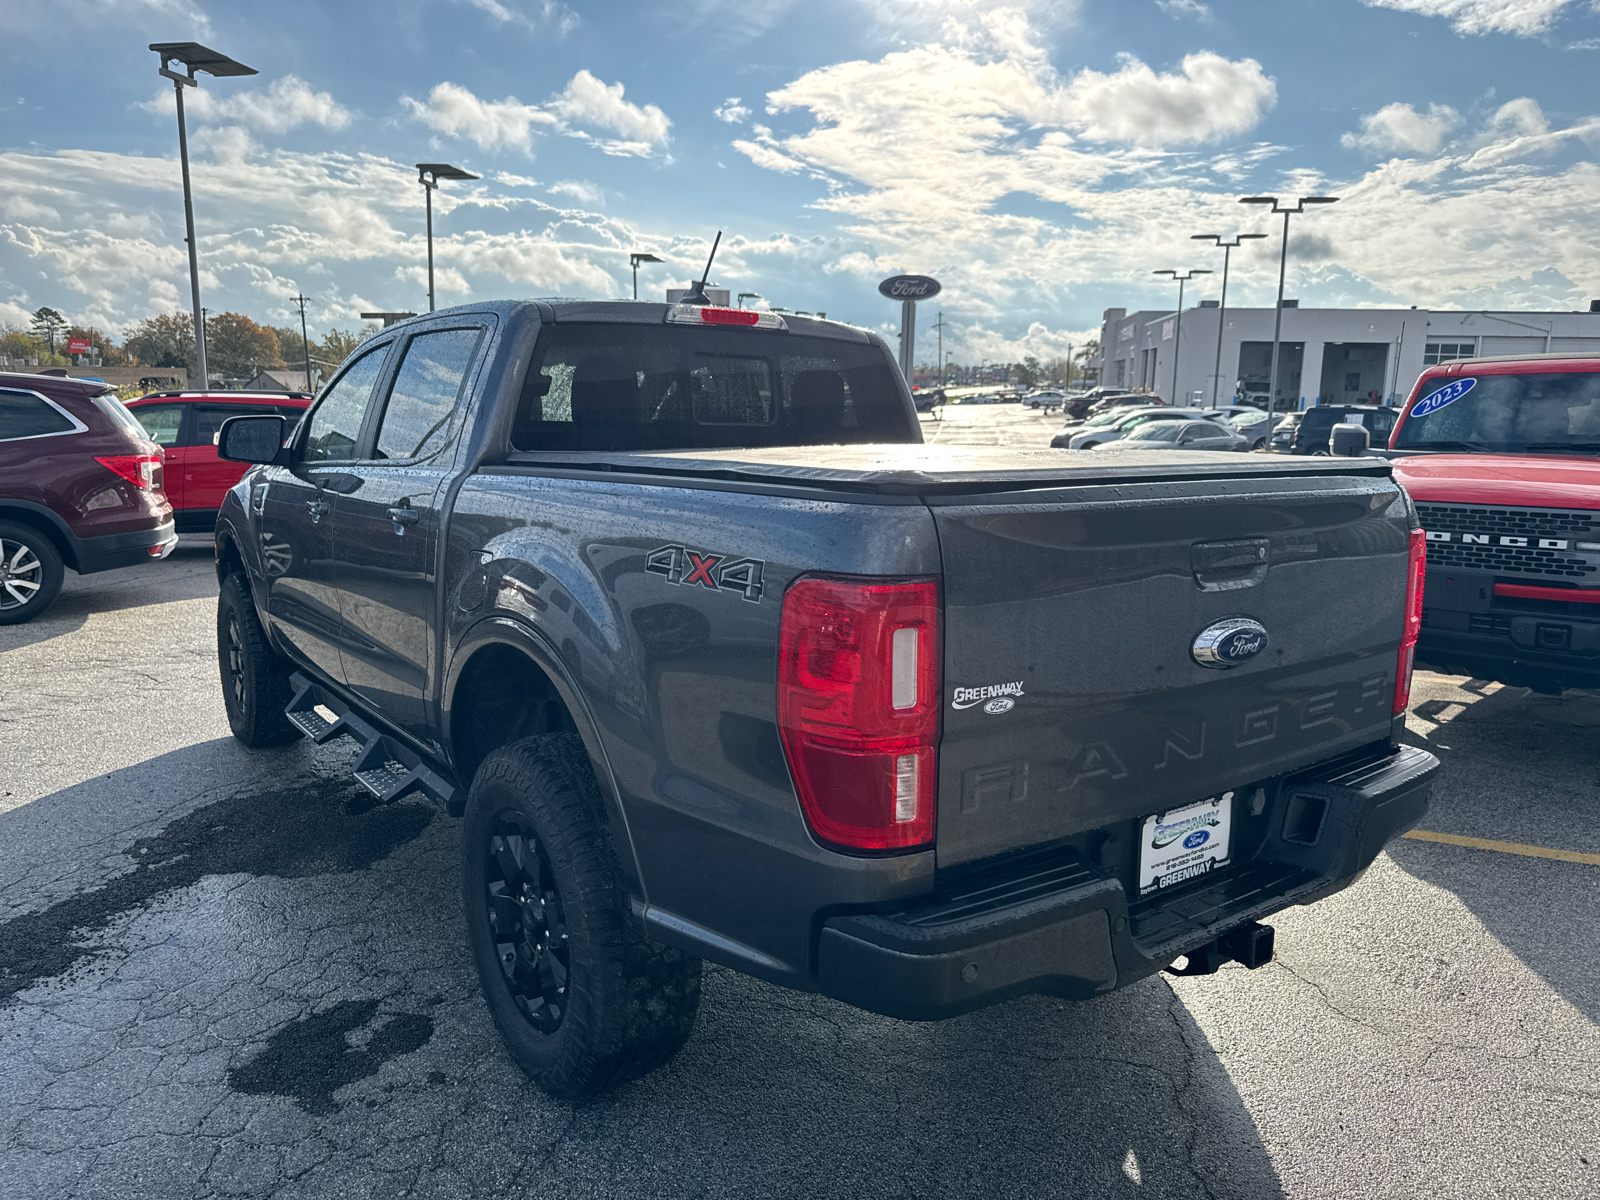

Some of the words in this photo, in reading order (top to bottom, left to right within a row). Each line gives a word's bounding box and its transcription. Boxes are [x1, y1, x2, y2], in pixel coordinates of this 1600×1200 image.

[891, 279, 929, 296] Ford
[1421, 381, 1464, 415] 2023
[1425, 531, 1568, 550] ONCO
[1229, 633, 1261, 658] Ford
[953, 680, 1025, 703] GREENWAY
[989, 699, 1009, 712] Ford
[960, 671, 1389, 814] RANGER
[1152, 809, 1220, 842] GREENWAY
[1187, 832, 1206, 848] Ford
[1150, 842, 1220, 870] www.greenwayfordkc.com
[1139, 884, 1158, 896] Raytown
[1159, 860, 1213, 889] GREENWAY
[1213, 858, 1231, 870] Missouri
